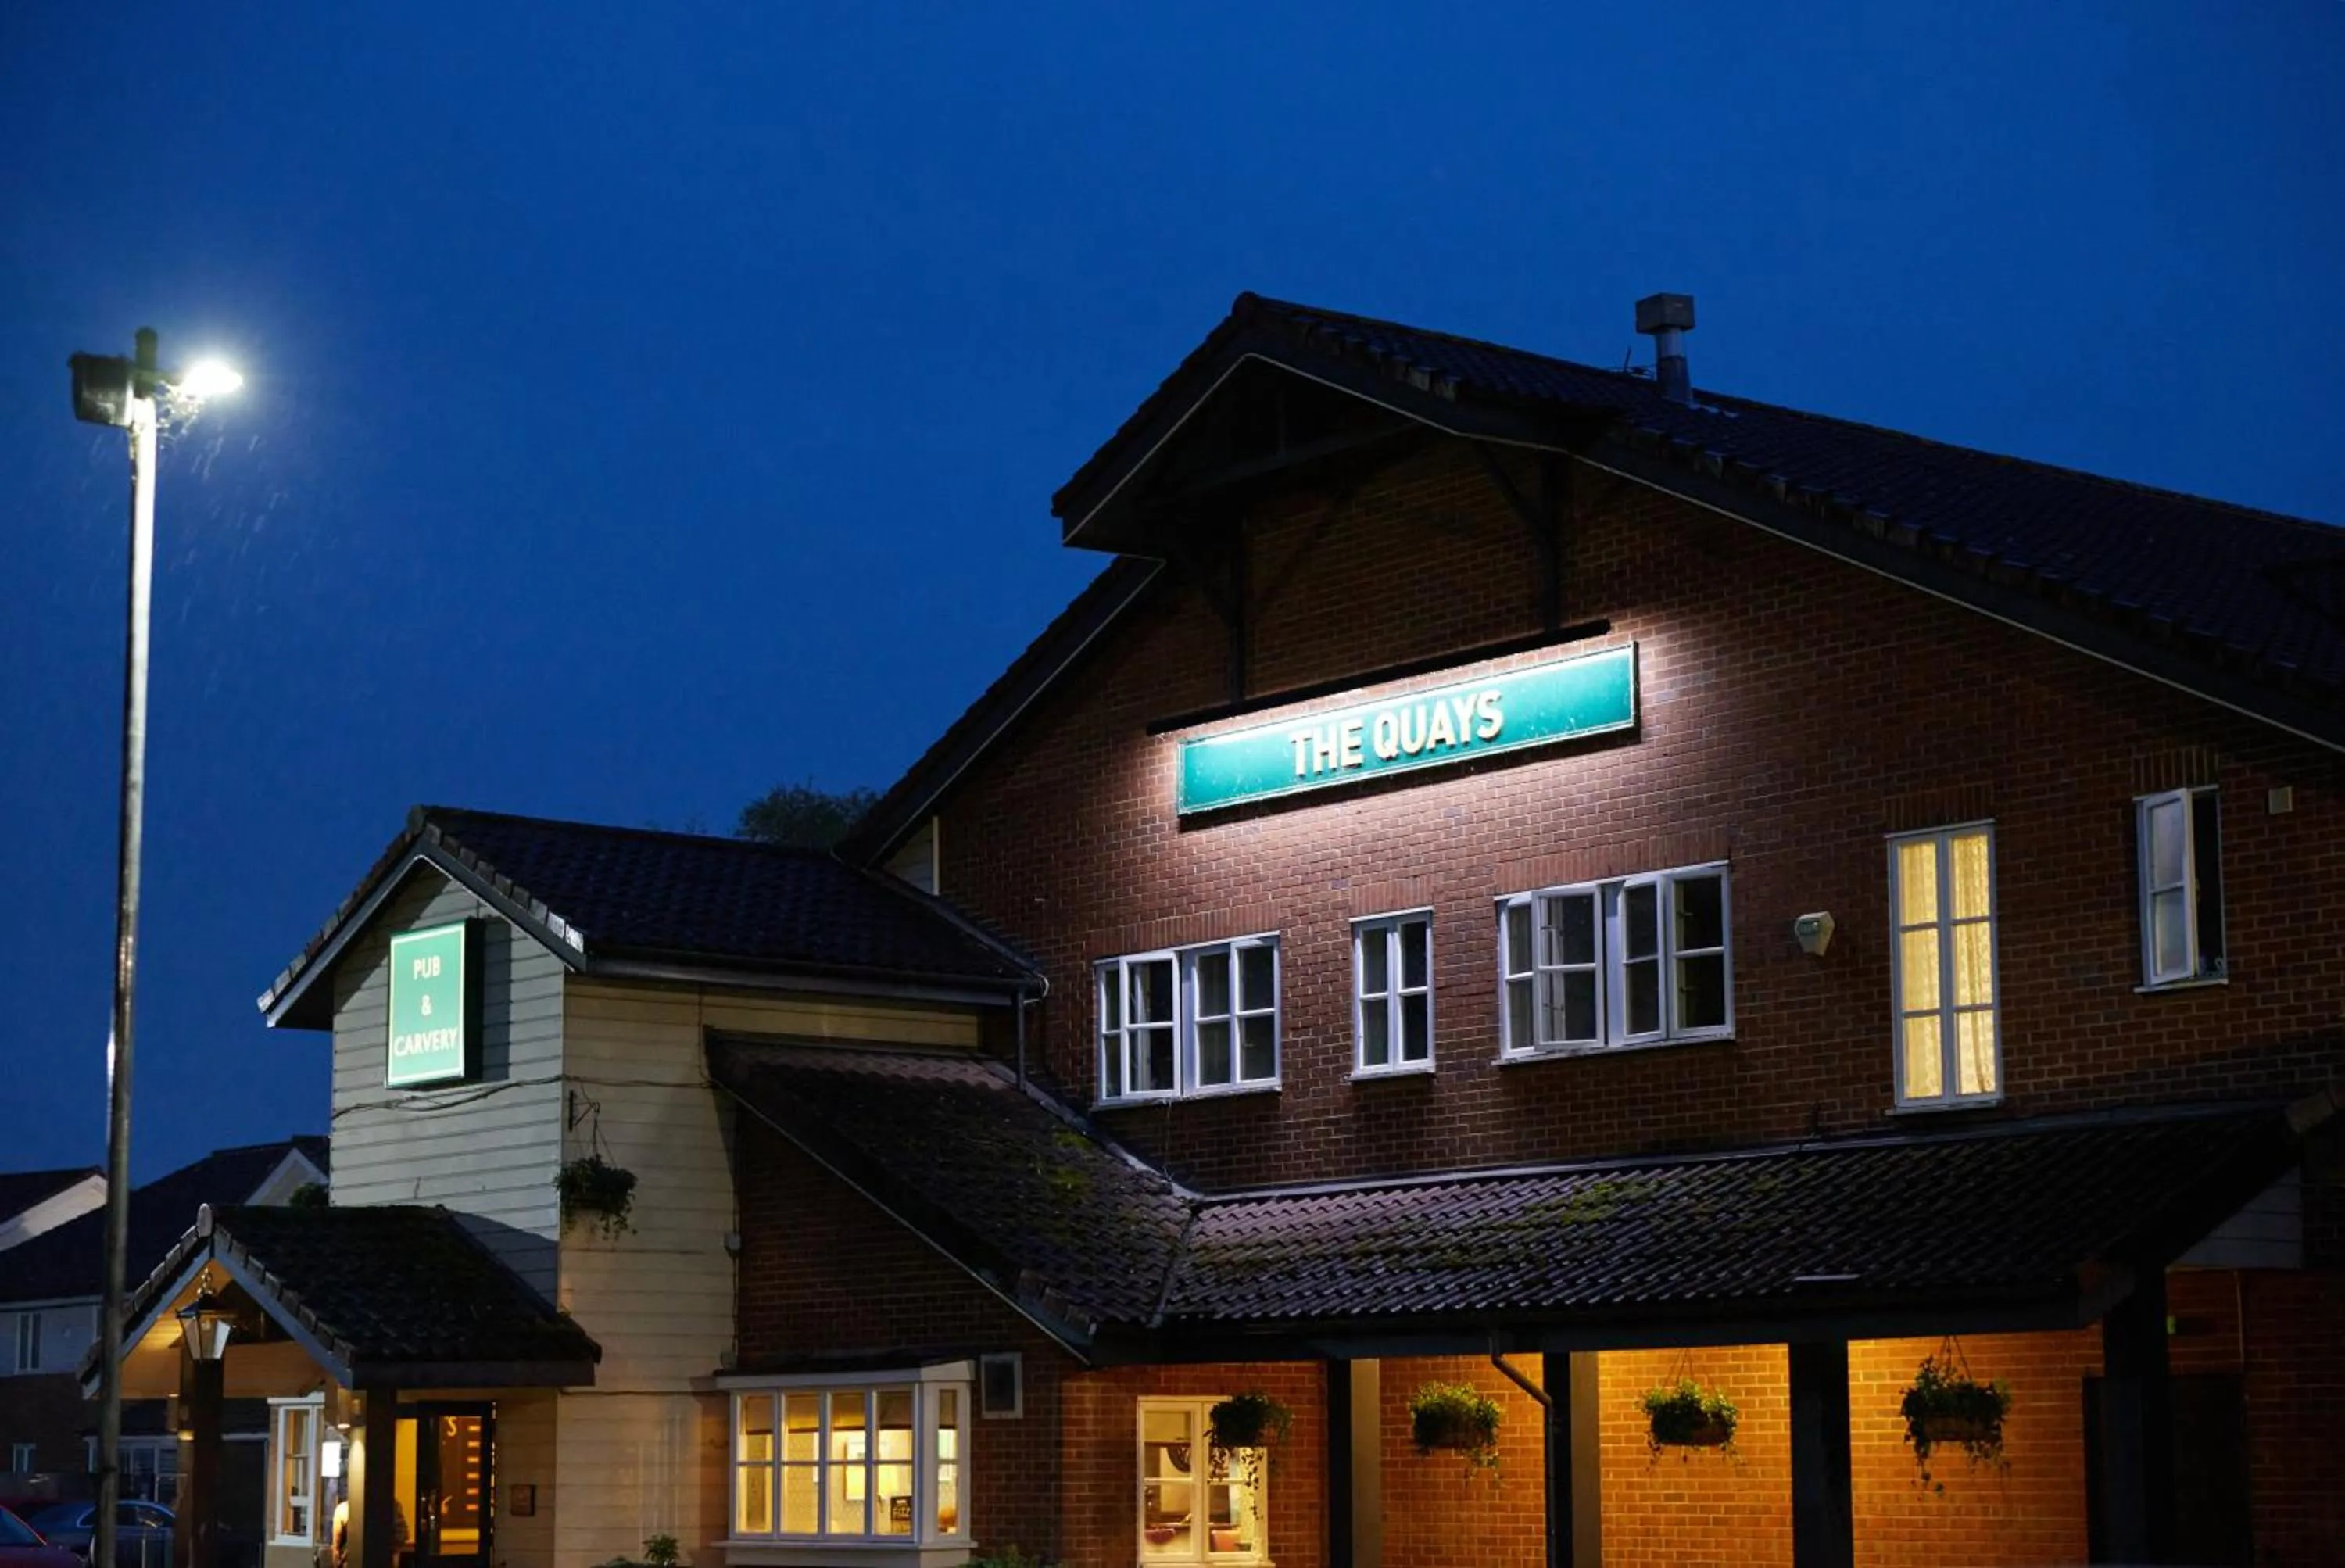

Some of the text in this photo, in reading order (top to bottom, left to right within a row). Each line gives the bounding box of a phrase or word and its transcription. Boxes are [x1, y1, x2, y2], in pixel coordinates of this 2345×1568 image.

[1289, 690, 1503, 776] THE QUAYS
[414, 955, 440, 980] PUB
[421, 994, 431, 1016] &
[394, 1027, 457, 1057] CARVERY
